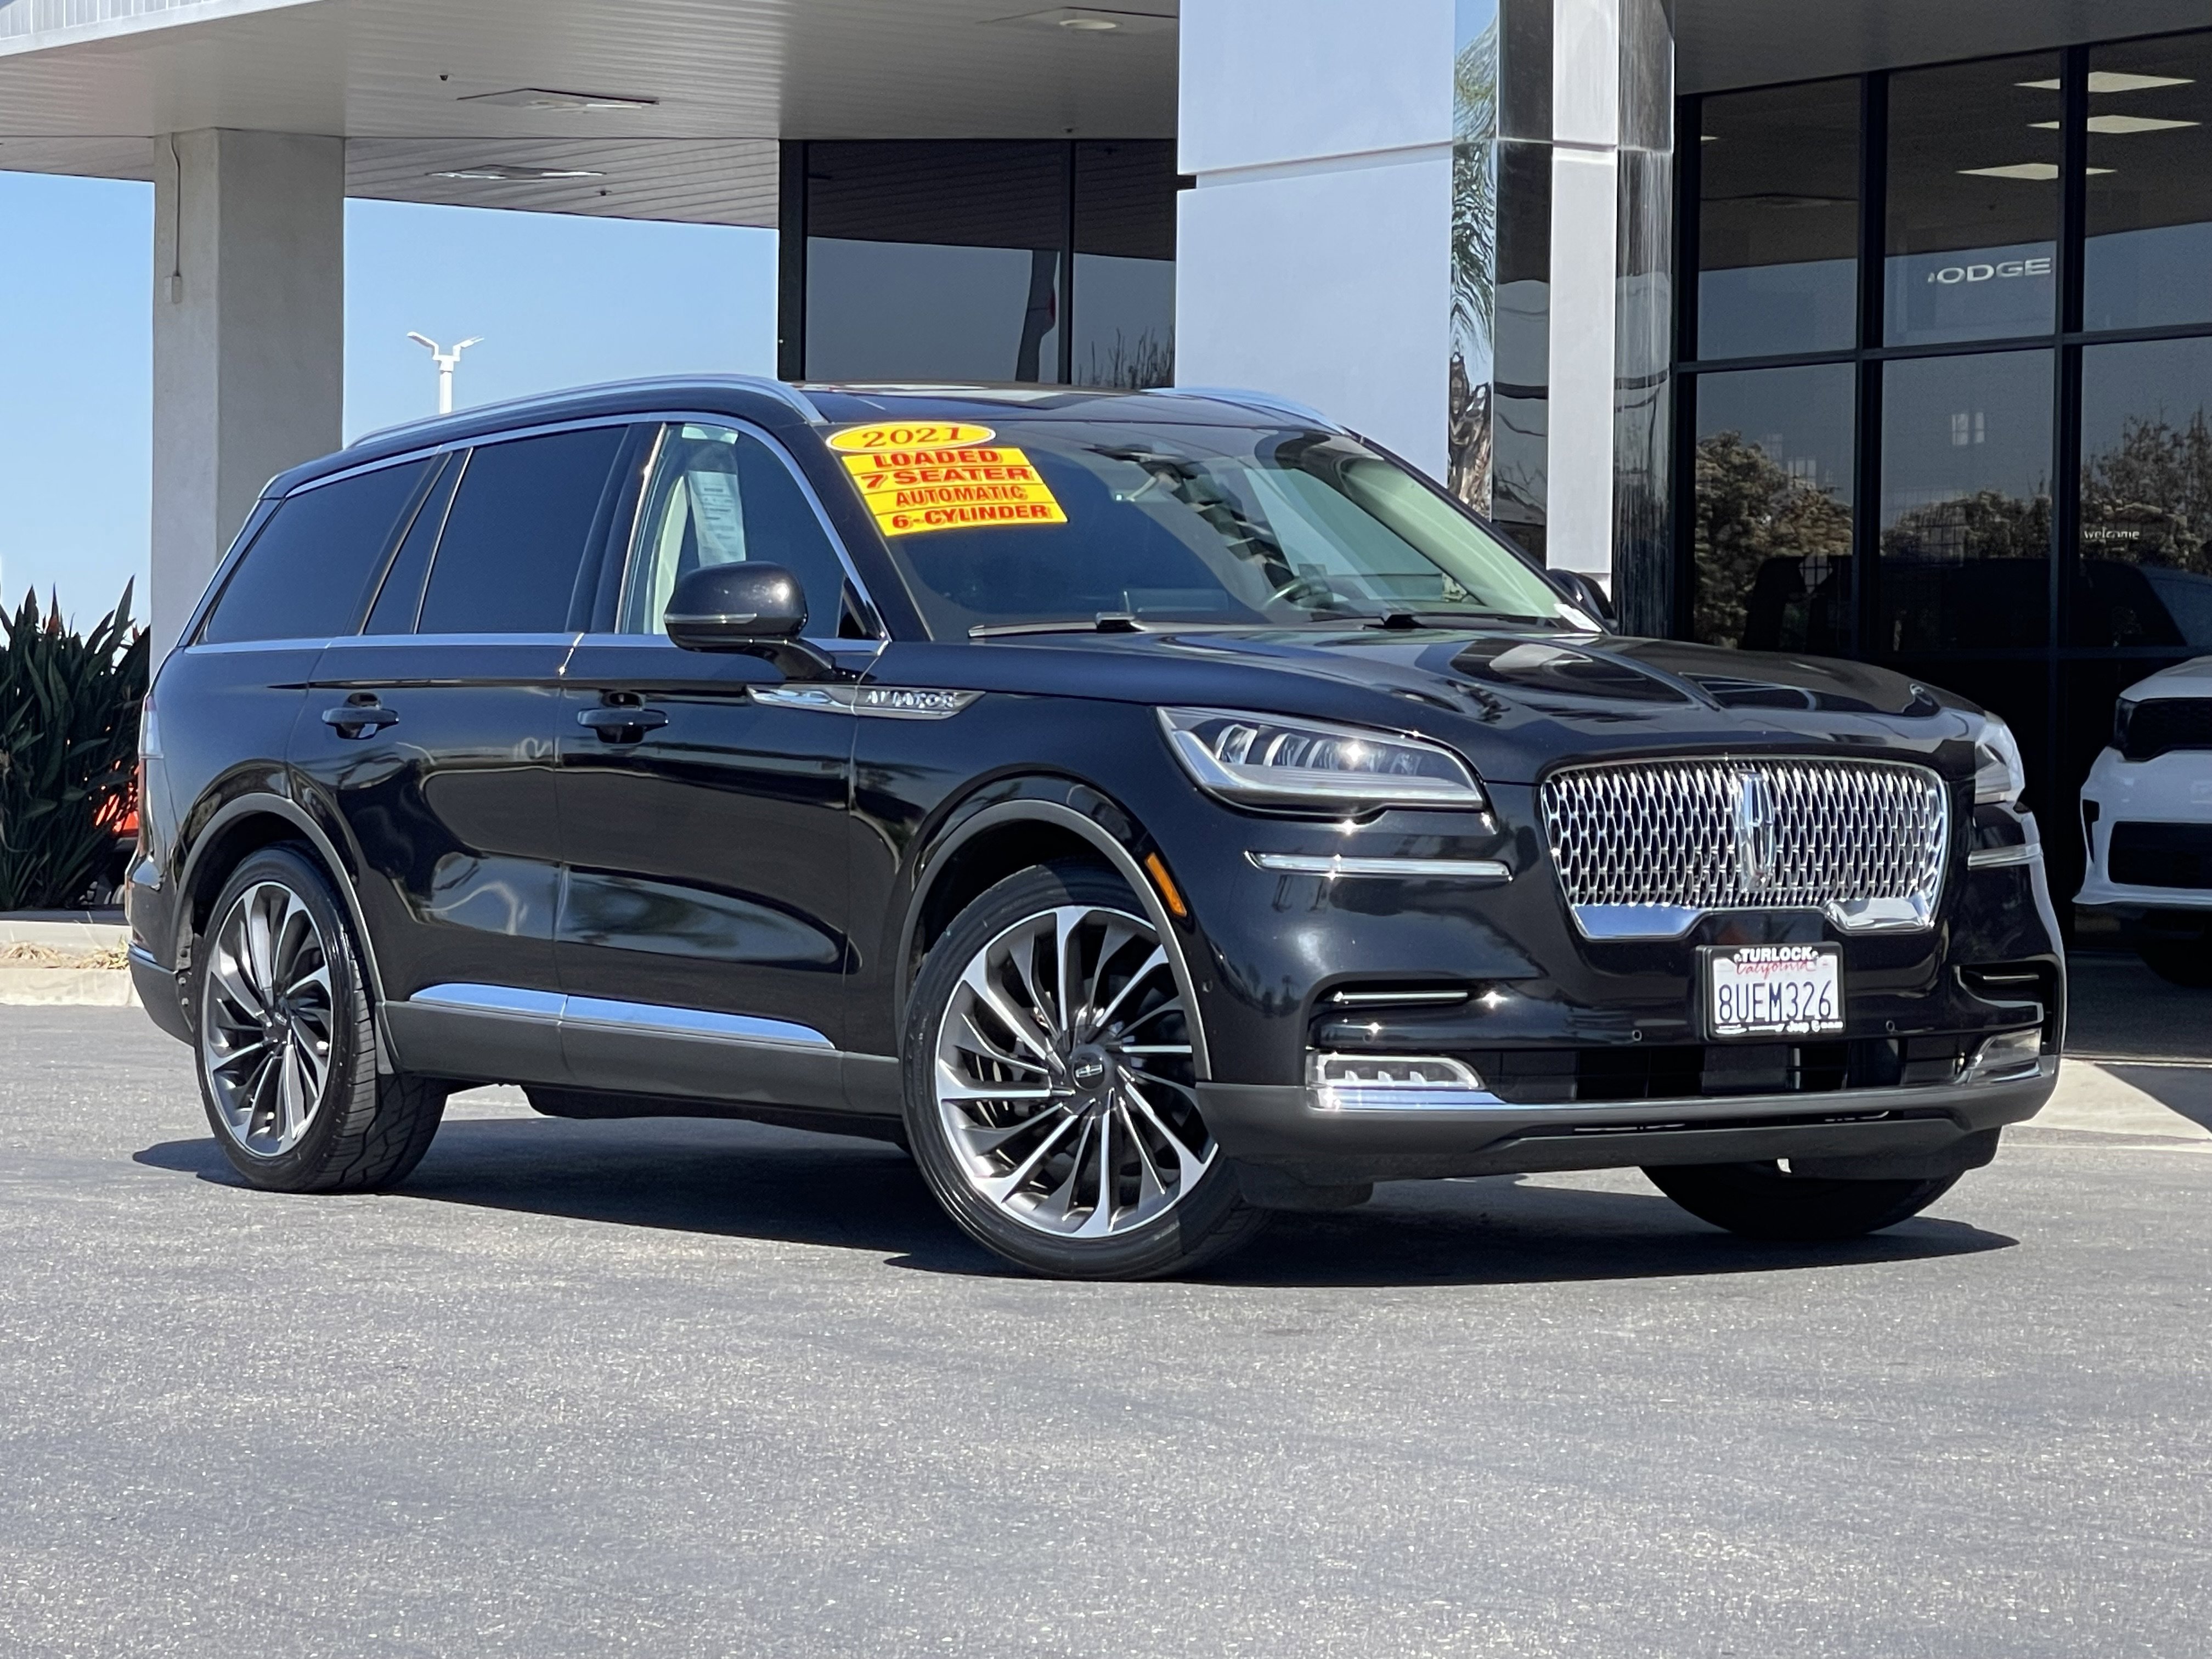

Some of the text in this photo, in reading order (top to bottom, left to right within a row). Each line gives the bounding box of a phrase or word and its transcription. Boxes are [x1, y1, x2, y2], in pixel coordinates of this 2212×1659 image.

[862, 427, 964, 448] 2021
[873, 450, 1000, 469] LOADED
[861, 467, 1036, 489] 7 SEATER
[895, 486, 1028, 507] AUTOMATIC
[892, 505, 1052, 529] 6-CYLINDER
[2084, 526, 2140, 540] welcome
[1739, 946, 1813, 963] TURLOCK
[1736, 960, 1816, 980] California
[1719, 980, 1831, 1023] 8UEM326
